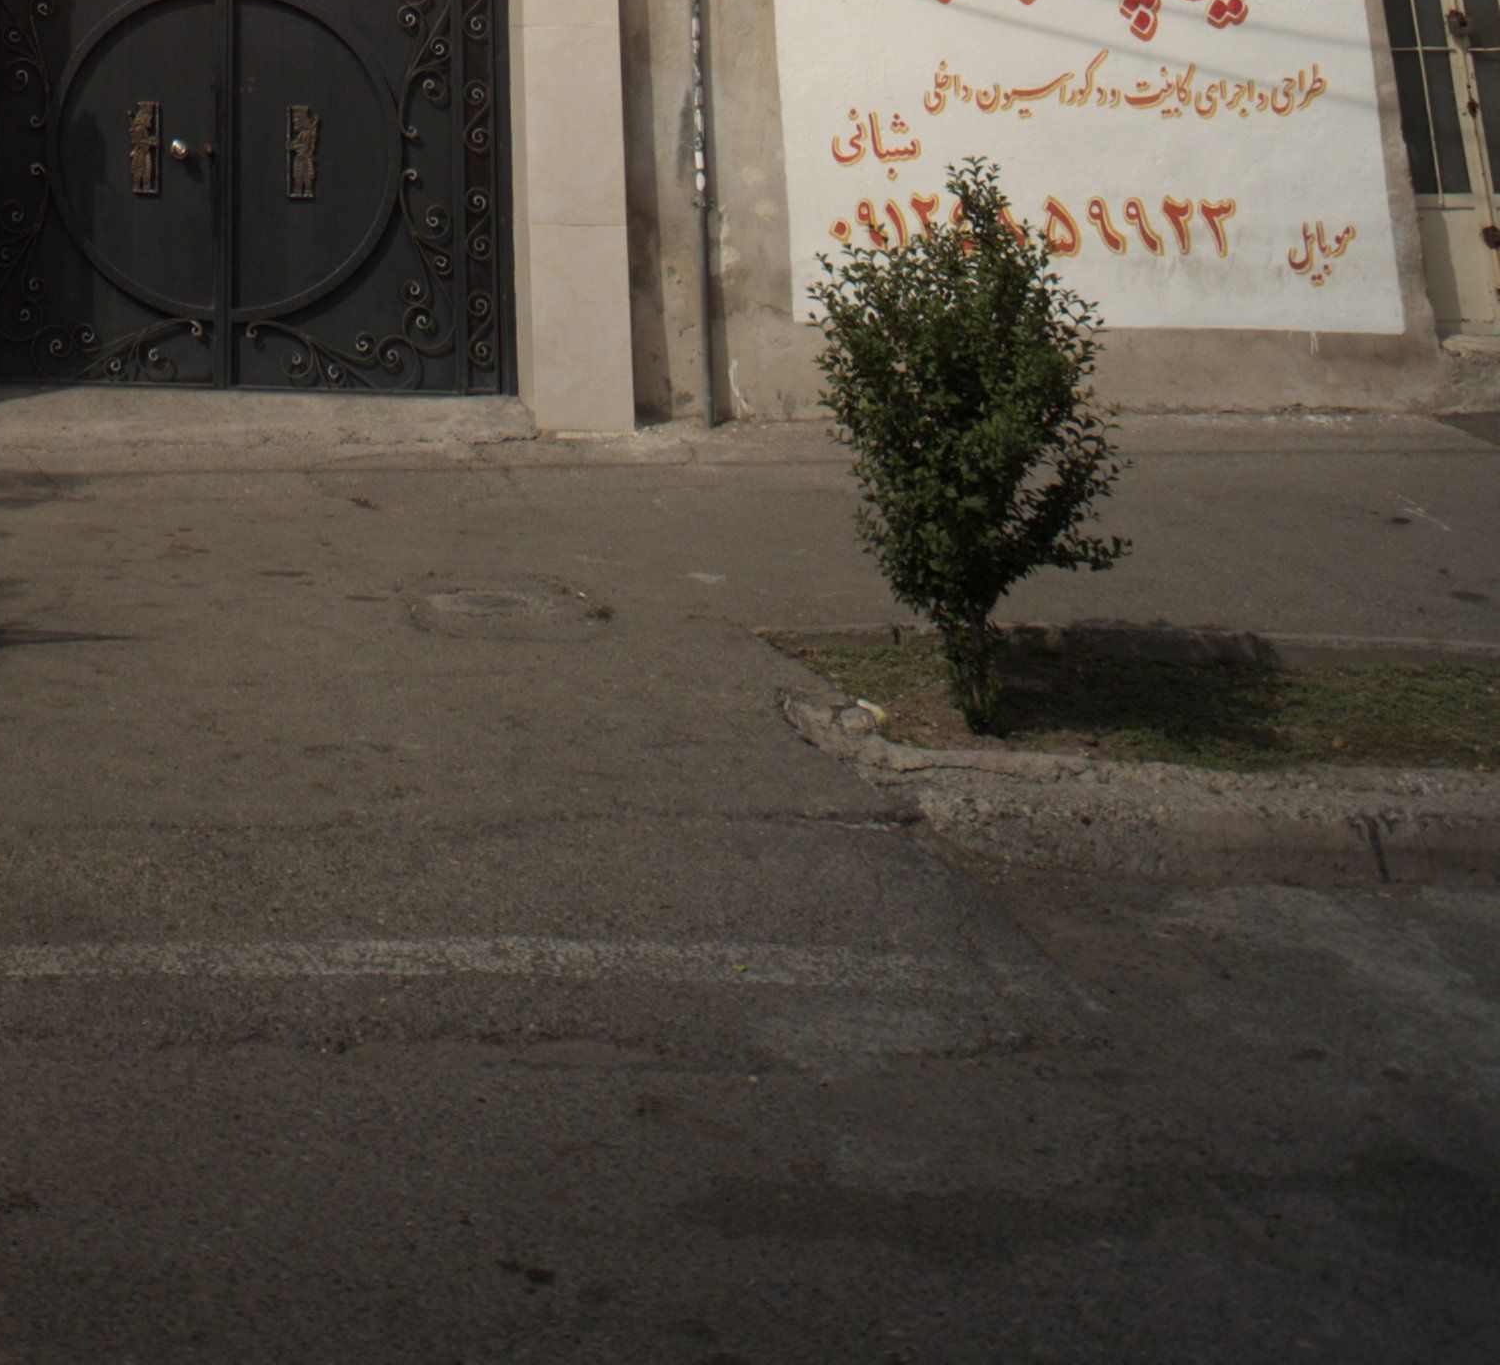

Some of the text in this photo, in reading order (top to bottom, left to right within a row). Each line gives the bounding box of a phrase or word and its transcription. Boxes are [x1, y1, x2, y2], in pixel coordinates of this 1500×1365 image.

[923, 59, 974, 116] داخلی
[975, 46, 1110, 121] دکوراسیون
[1123, 61, 1197, 121] کابینت
[1194, 77, 1255, 120] اجرای
[1269, 63, 1328, 117] طراحی
[831, 106, 923, 181] شبانی
[1288, 220, 1357, 286] موبایل
